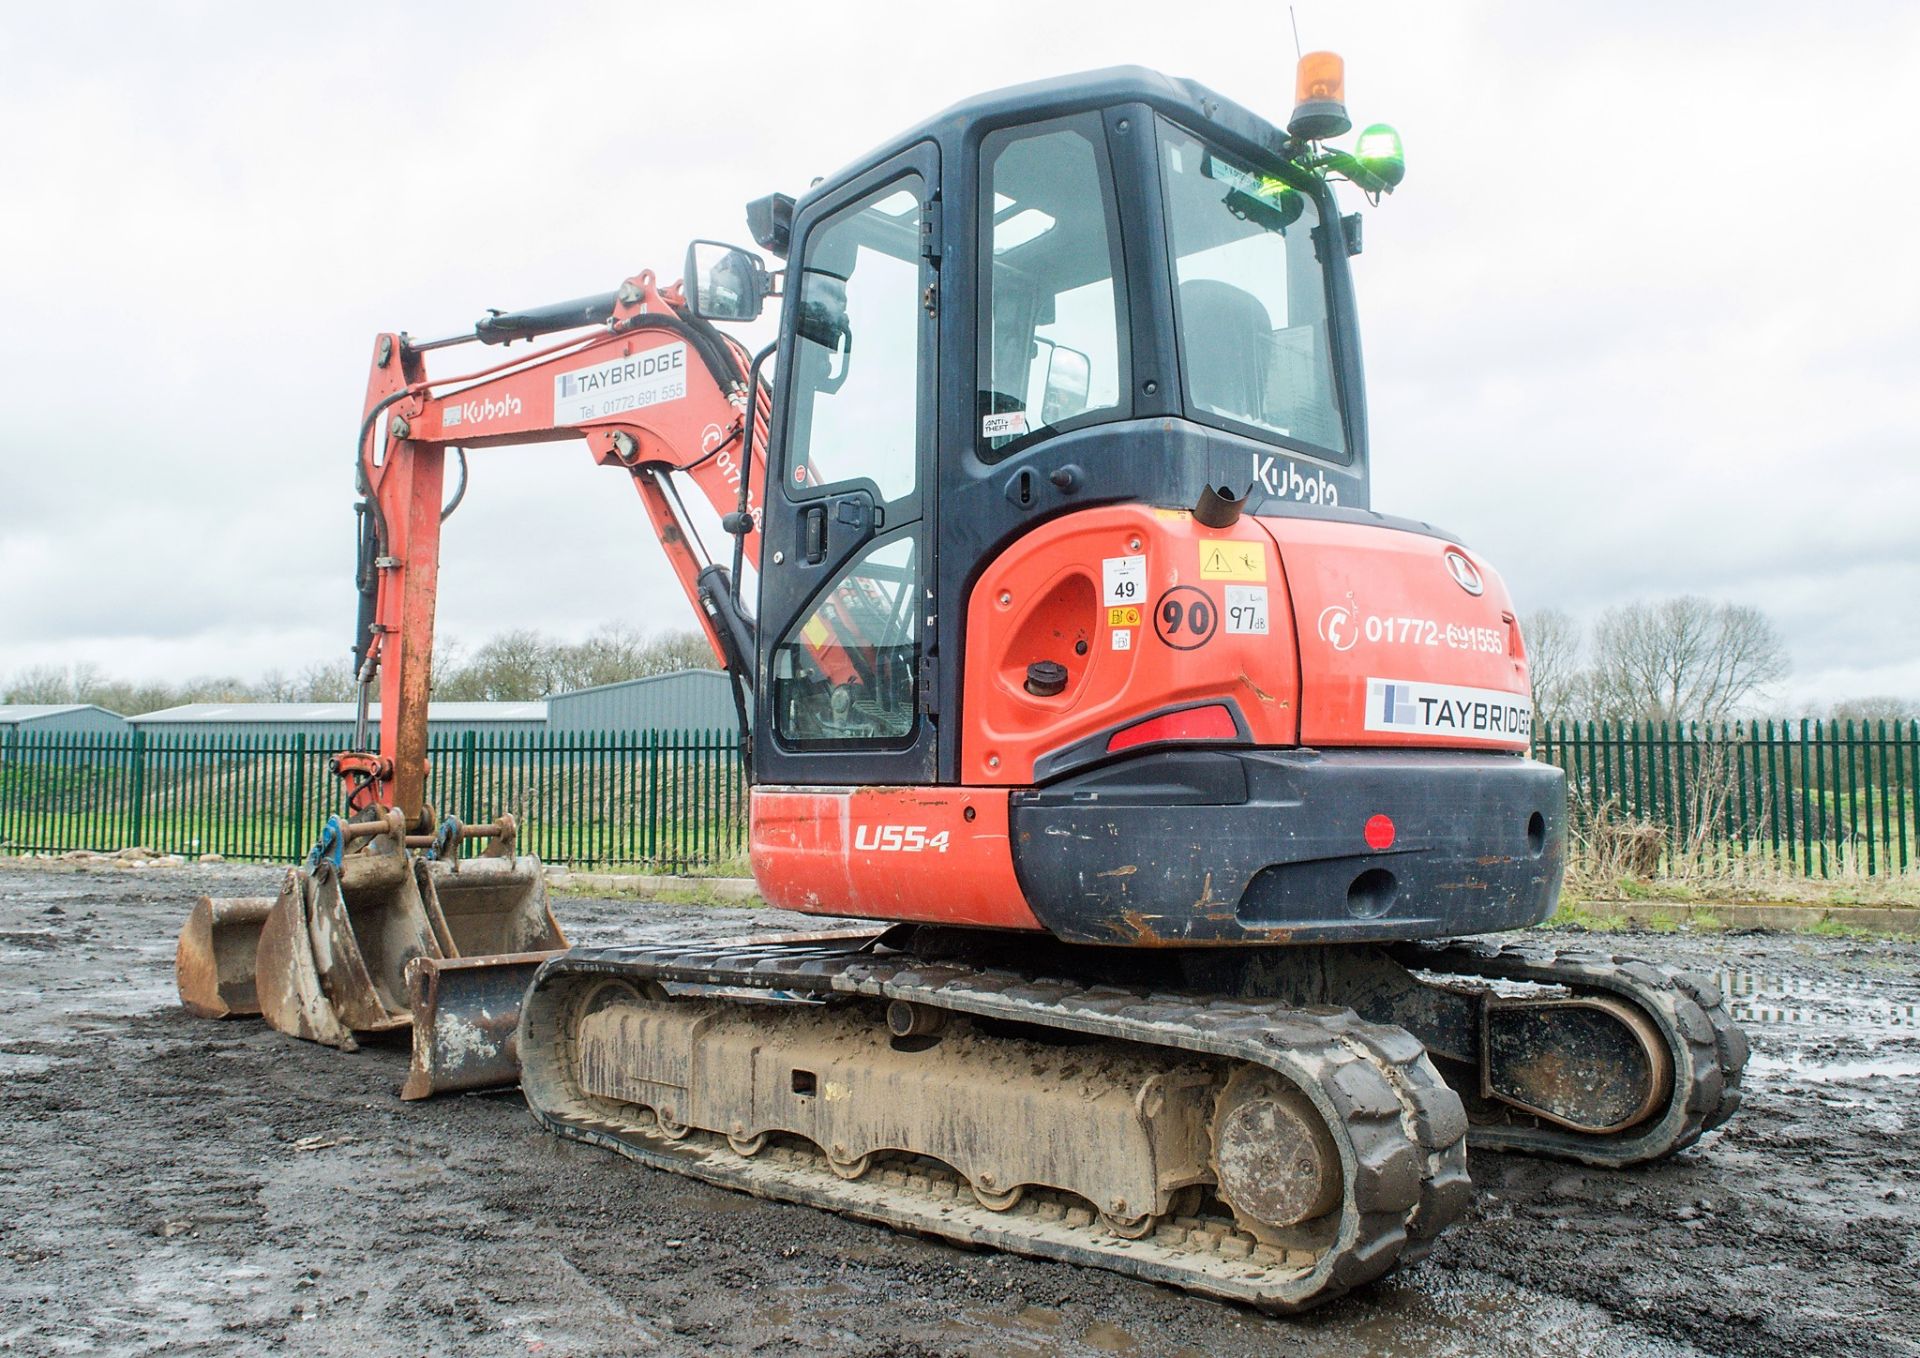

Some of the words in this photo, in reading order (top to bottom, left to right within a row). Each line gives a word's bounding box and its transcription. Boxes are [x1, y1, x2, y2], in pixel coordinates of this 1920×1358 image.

[578, 350, 683, 392] TAYBRIDGE
[463, 393, 522, 424] Kubota
[602, 395, 634, 415] 01772
[638, 390, 657, 406] 691
[661, 382, 683, 400] 555
[985, 424, 1009, 432] THEFT
[1252, 453, 1338, 507] Kubota
[1163, 600, 1209, 635] 90
[1365, 615, 1503, 654] 01772-691555
[1418, 697, 1530, 735] TAYBRIDGE
